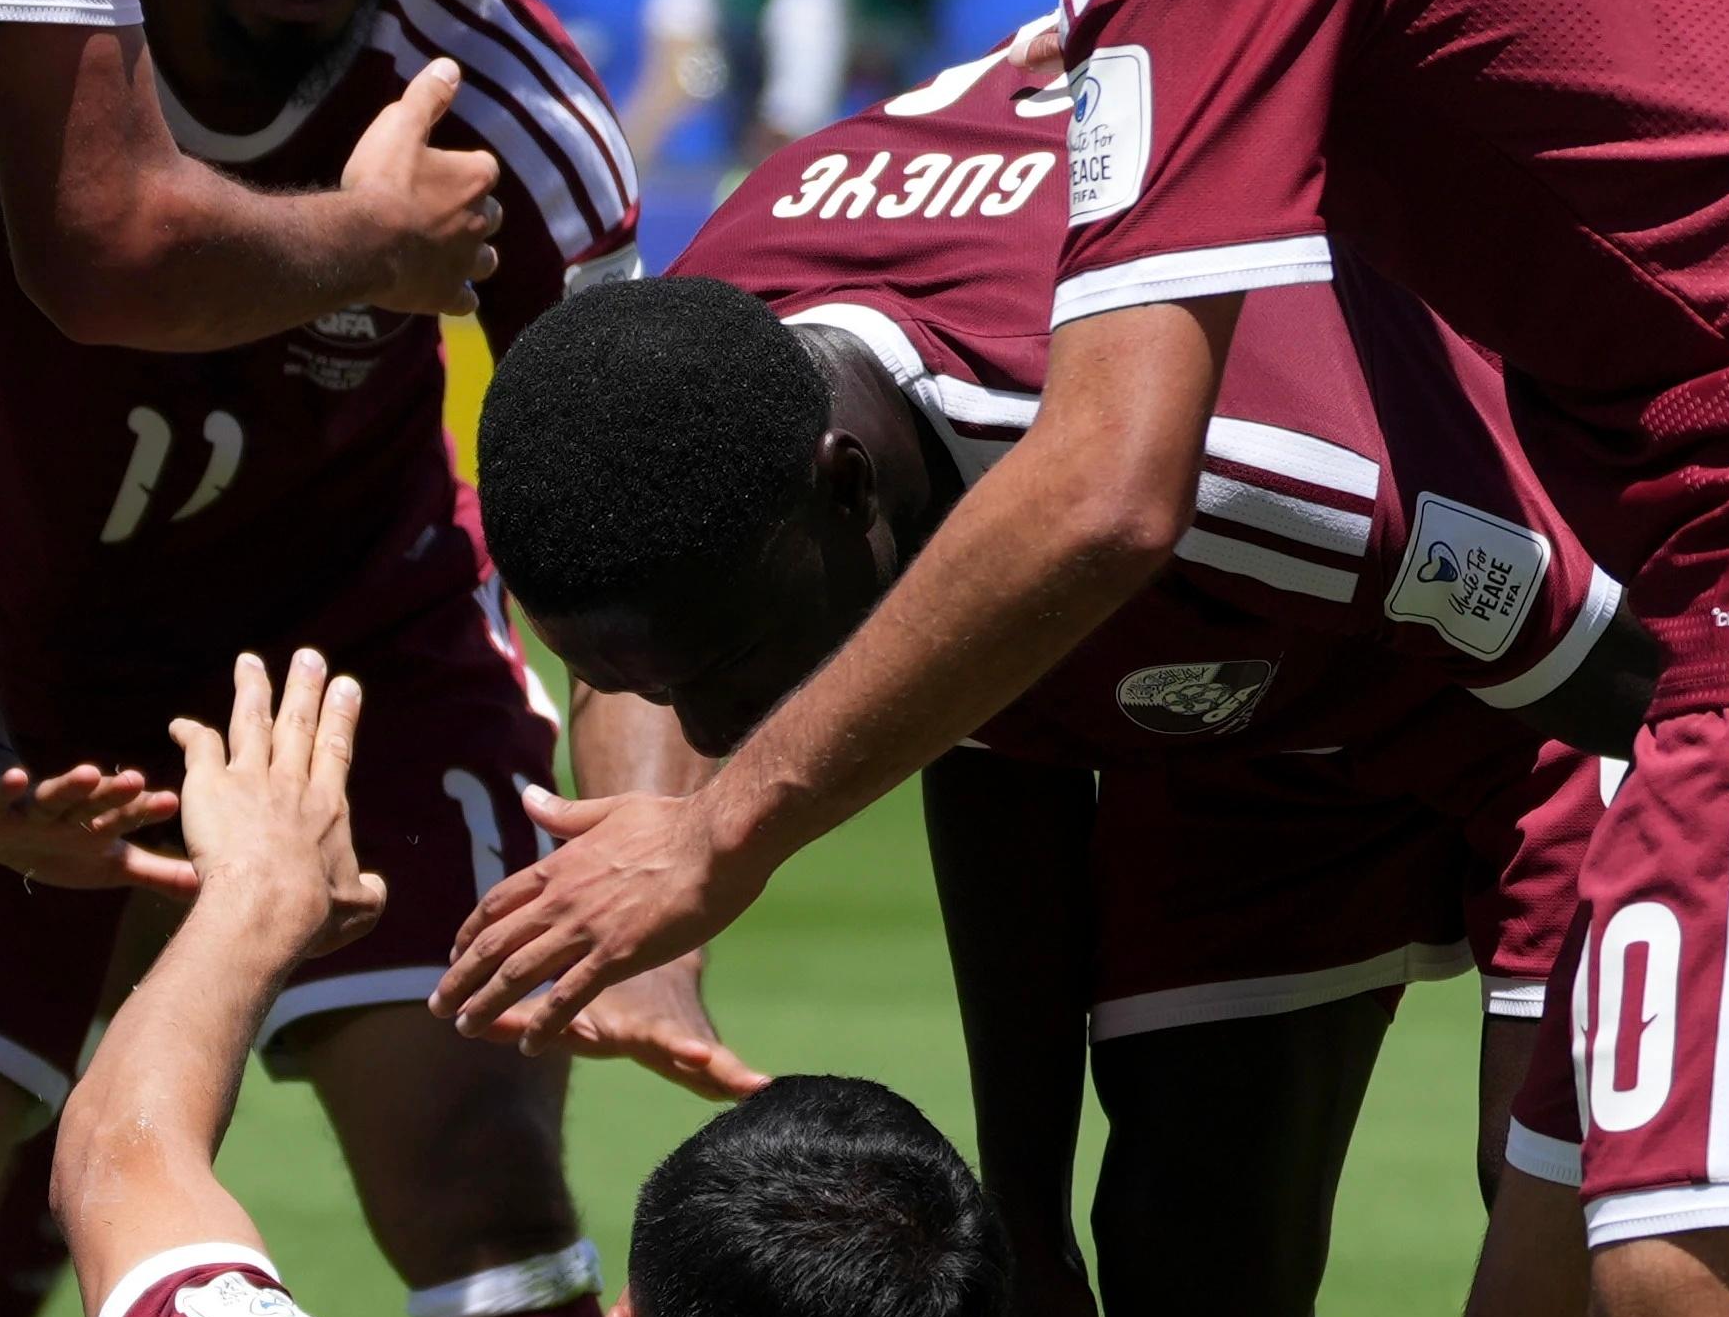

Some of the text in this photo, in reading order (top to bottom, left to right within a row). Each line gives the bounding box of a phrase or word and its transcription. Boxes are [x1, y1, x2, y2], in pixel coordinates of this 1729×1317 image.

[1090, 123, 1116, 149] For
[772, 151, 1056, 219] GUEYE
[1069, 155, 1113, 187] EACE
[1072, 188, 1098, 206] FIFA
[1448, 546, 1488, 616] Unite For
[1471, 558, 1513, 622] PEACE
[1500, 582, 1522, 617] FIFA
